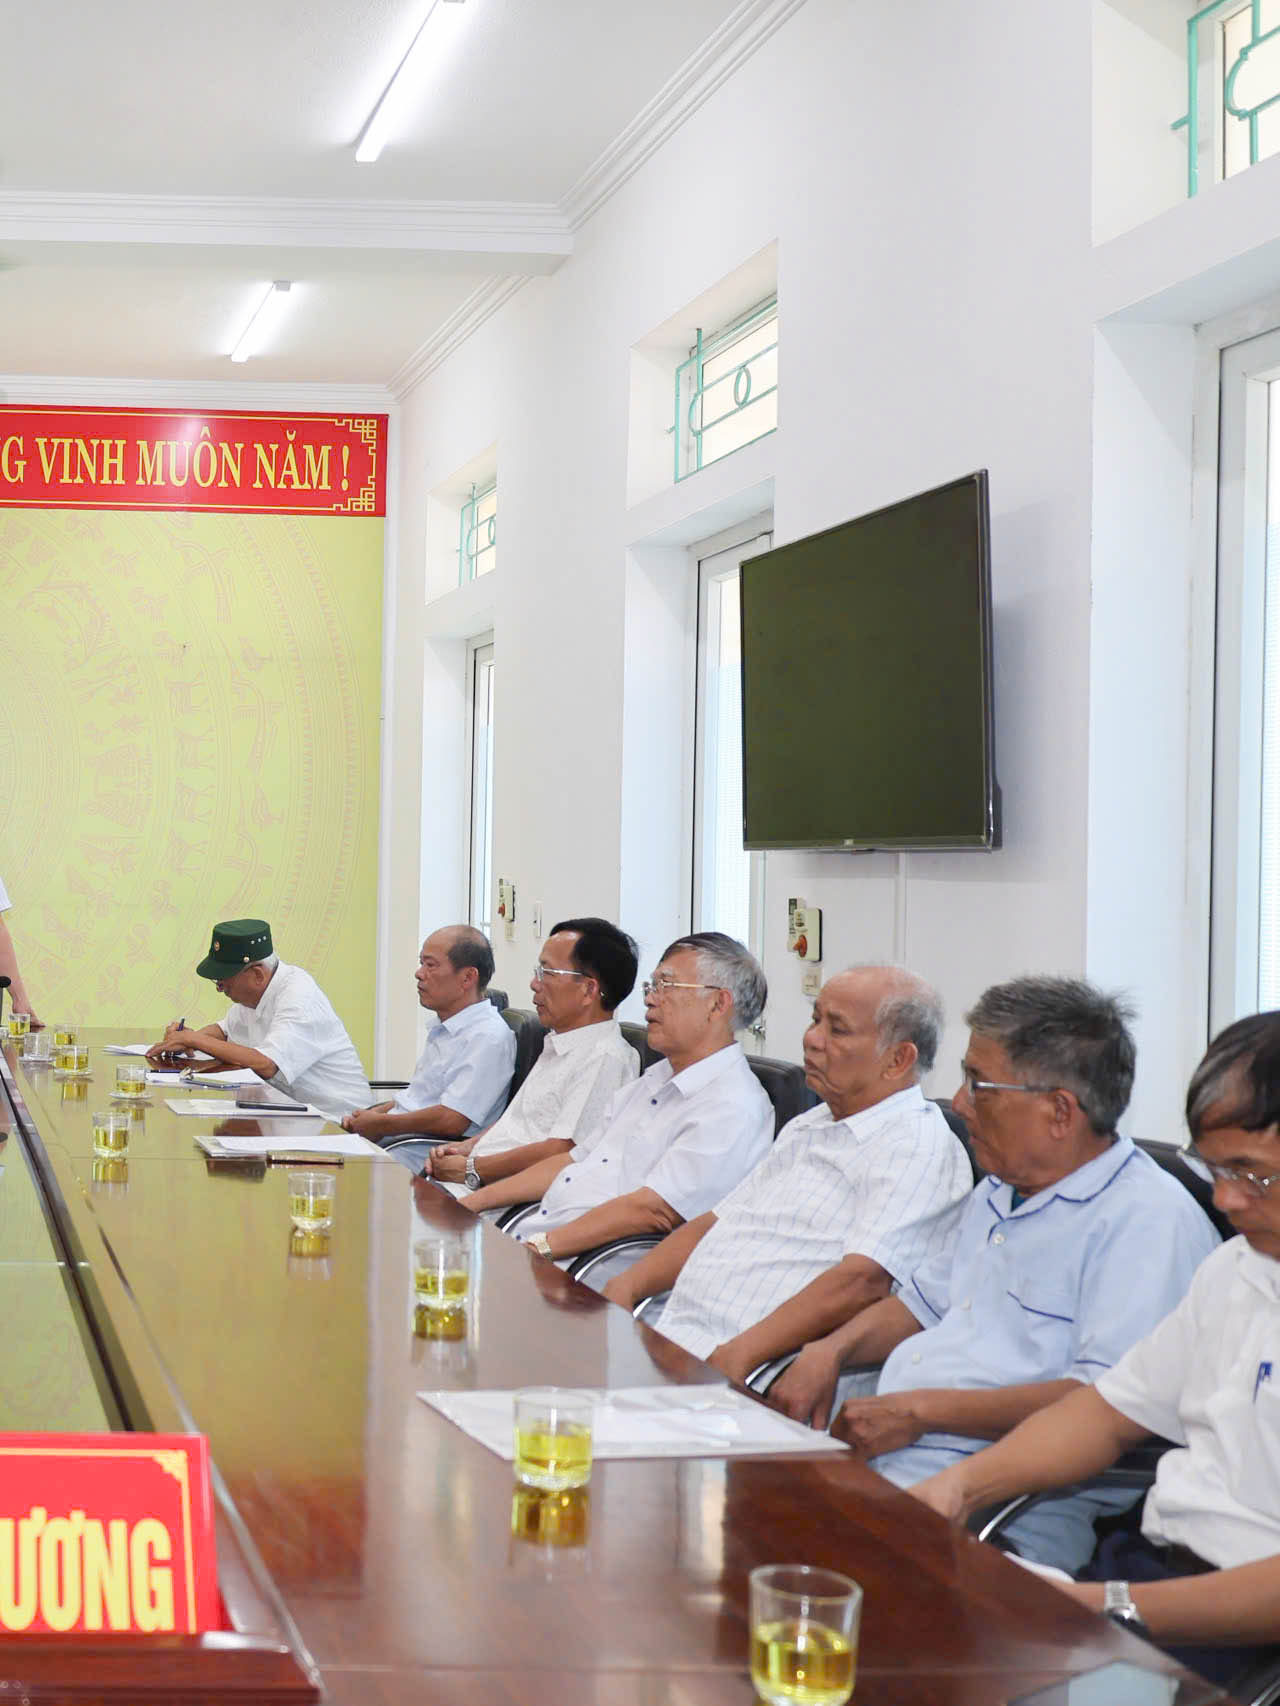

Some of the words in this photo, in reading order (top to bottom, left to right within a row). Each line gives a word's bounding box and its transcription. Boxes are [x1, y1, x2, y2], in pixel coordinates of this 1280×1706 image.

[35, 437, 126, 486] VINH
[135, 426, 244, 489] MUÔN
[252, 430, 332, 490] NĂM
[340, 444, 351, 490] !
